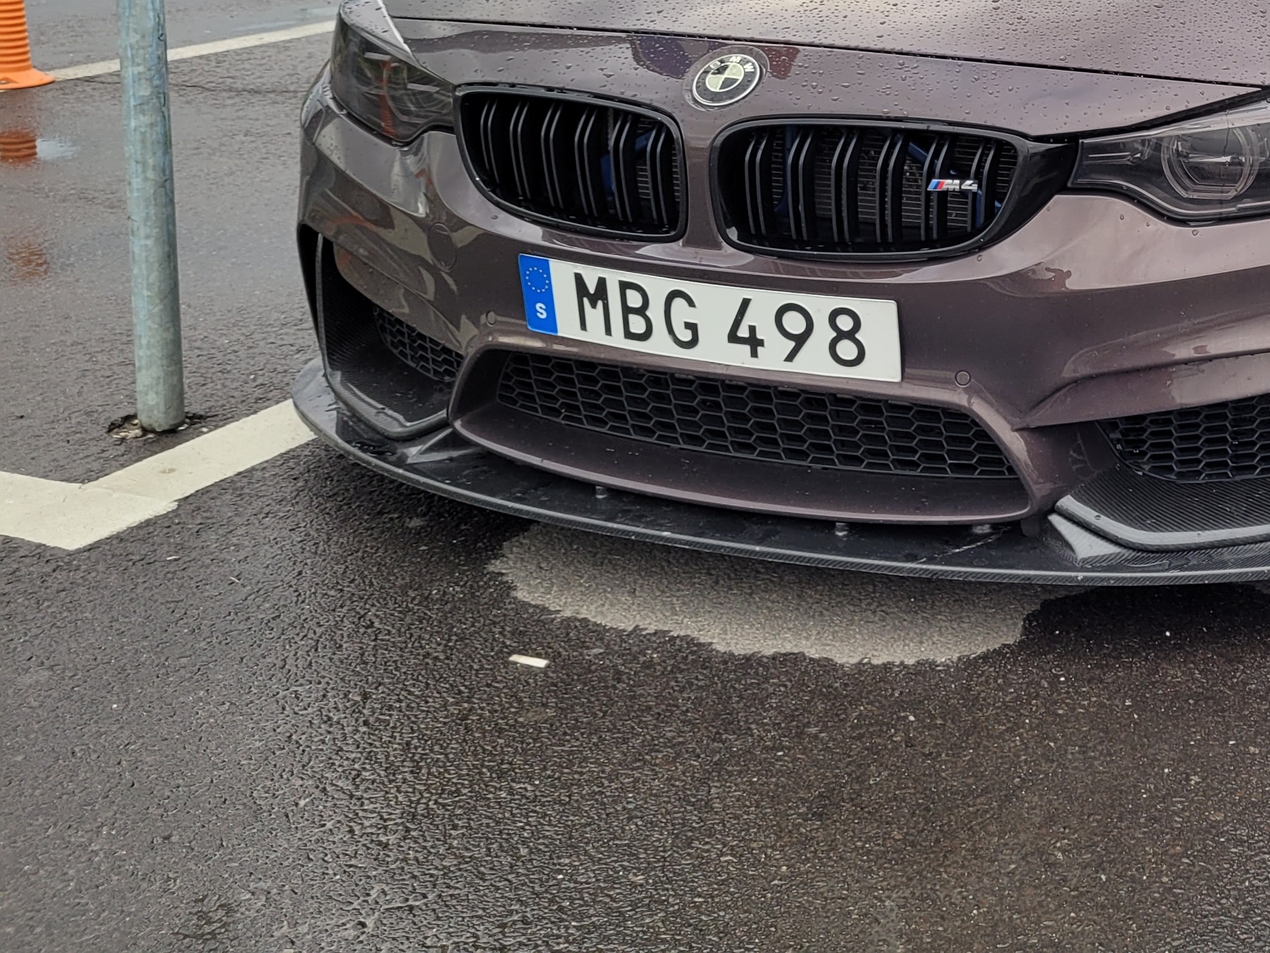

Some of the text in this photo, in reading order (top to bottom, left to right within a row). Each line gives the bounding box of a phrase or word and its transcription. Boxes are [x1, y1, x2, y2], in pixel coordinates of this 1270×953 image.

[709, 56, 755, 72] BMW
[535, 302, 548, 320] S
[573, 271, 866, 368] MBG 498
